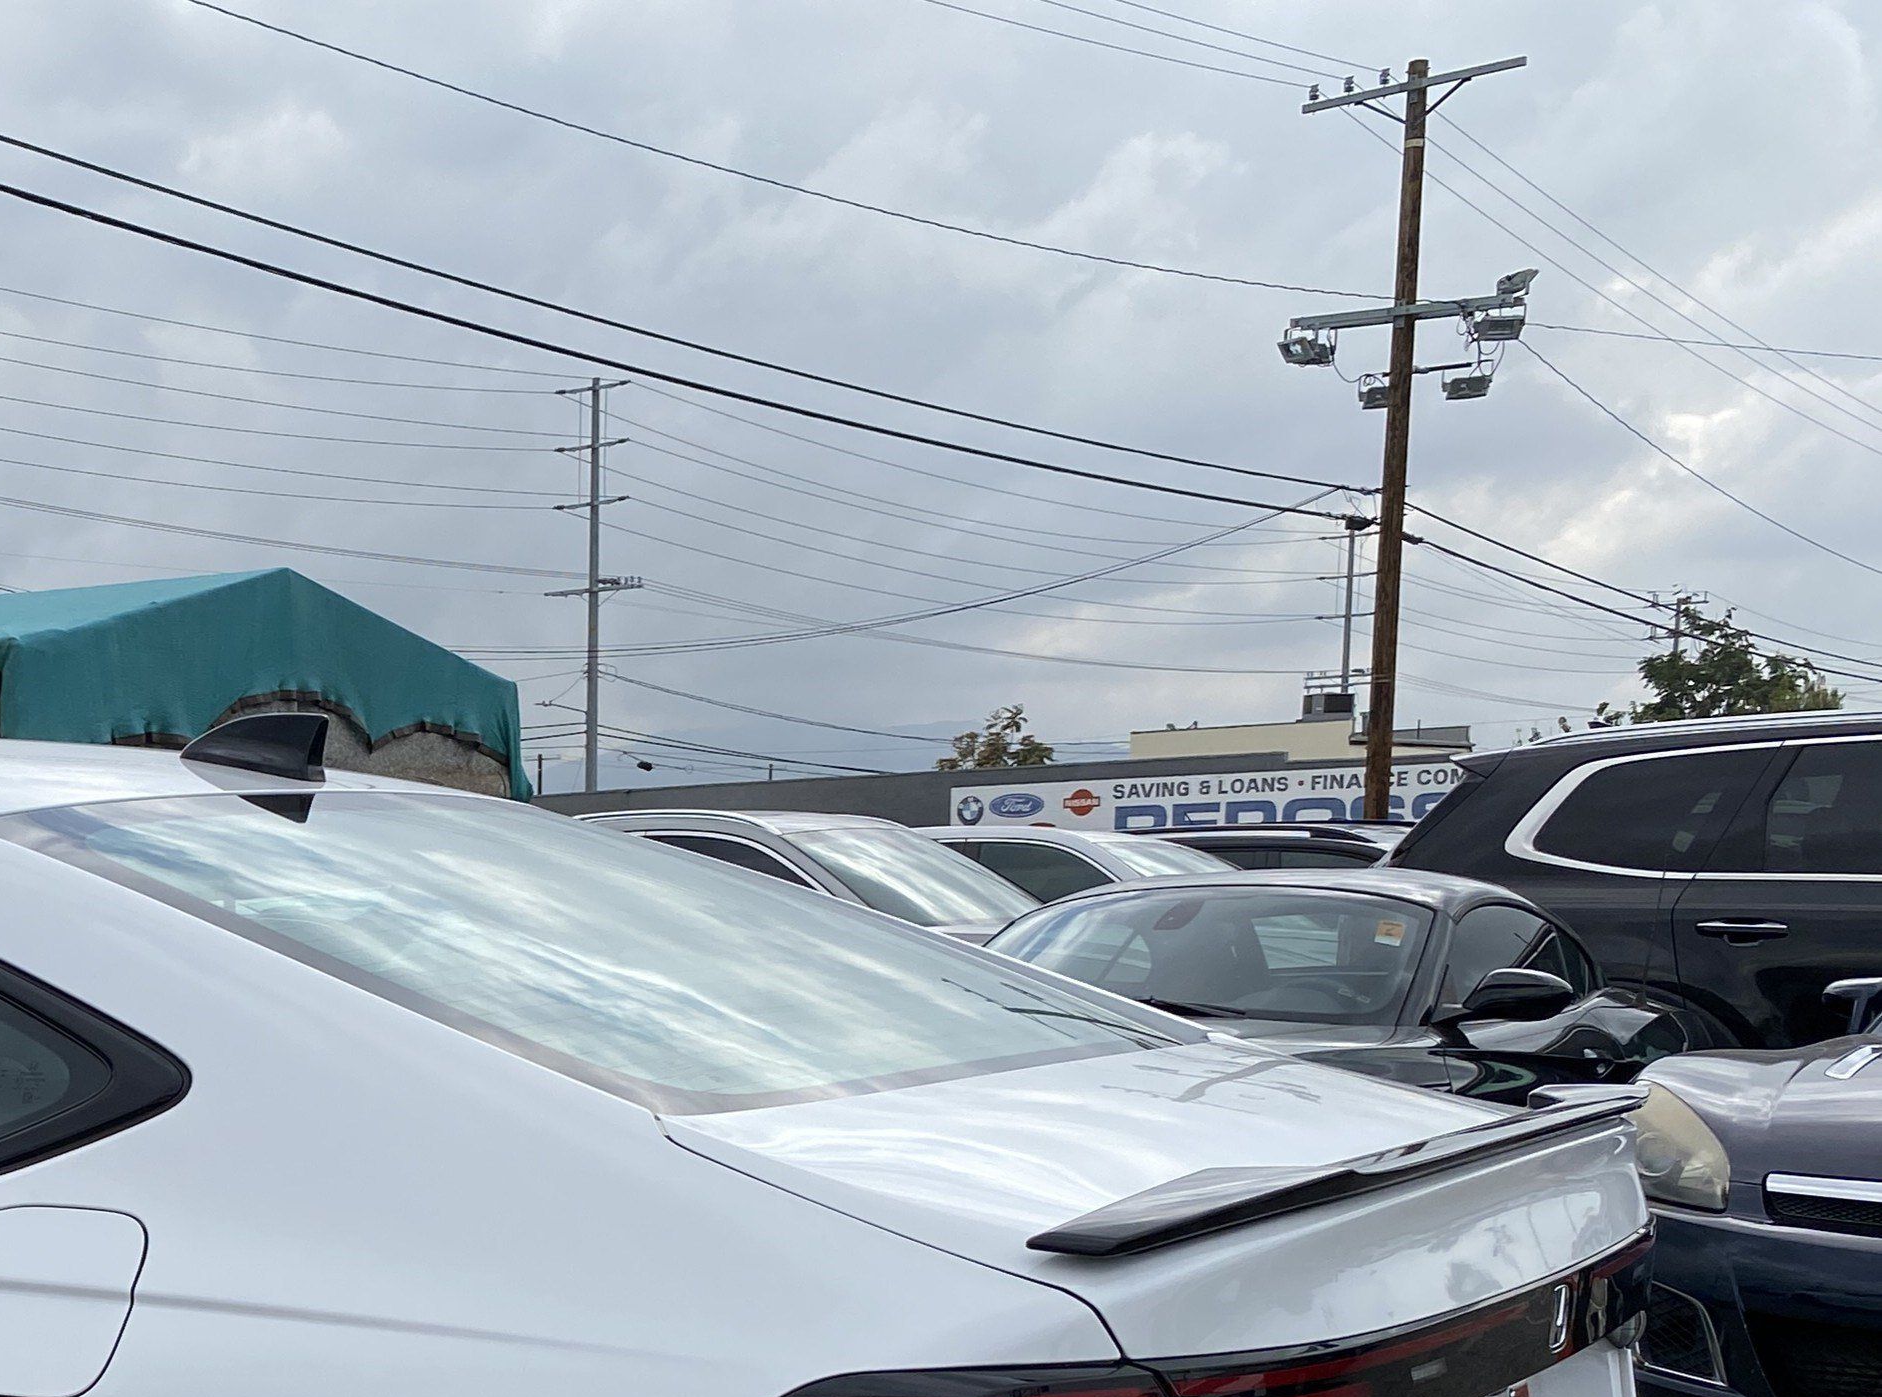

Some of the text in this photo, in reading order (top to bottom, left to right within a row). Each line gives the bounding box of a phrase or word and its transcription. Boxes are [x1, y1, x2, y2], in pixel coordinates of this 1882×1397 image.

[1112, 781, 1190, 800] SAVING
[1199, 780, 1211, 795] &
[1217, 776, 1289, 796] LOANS
[1310, 770, 1409, 791] FINAE
